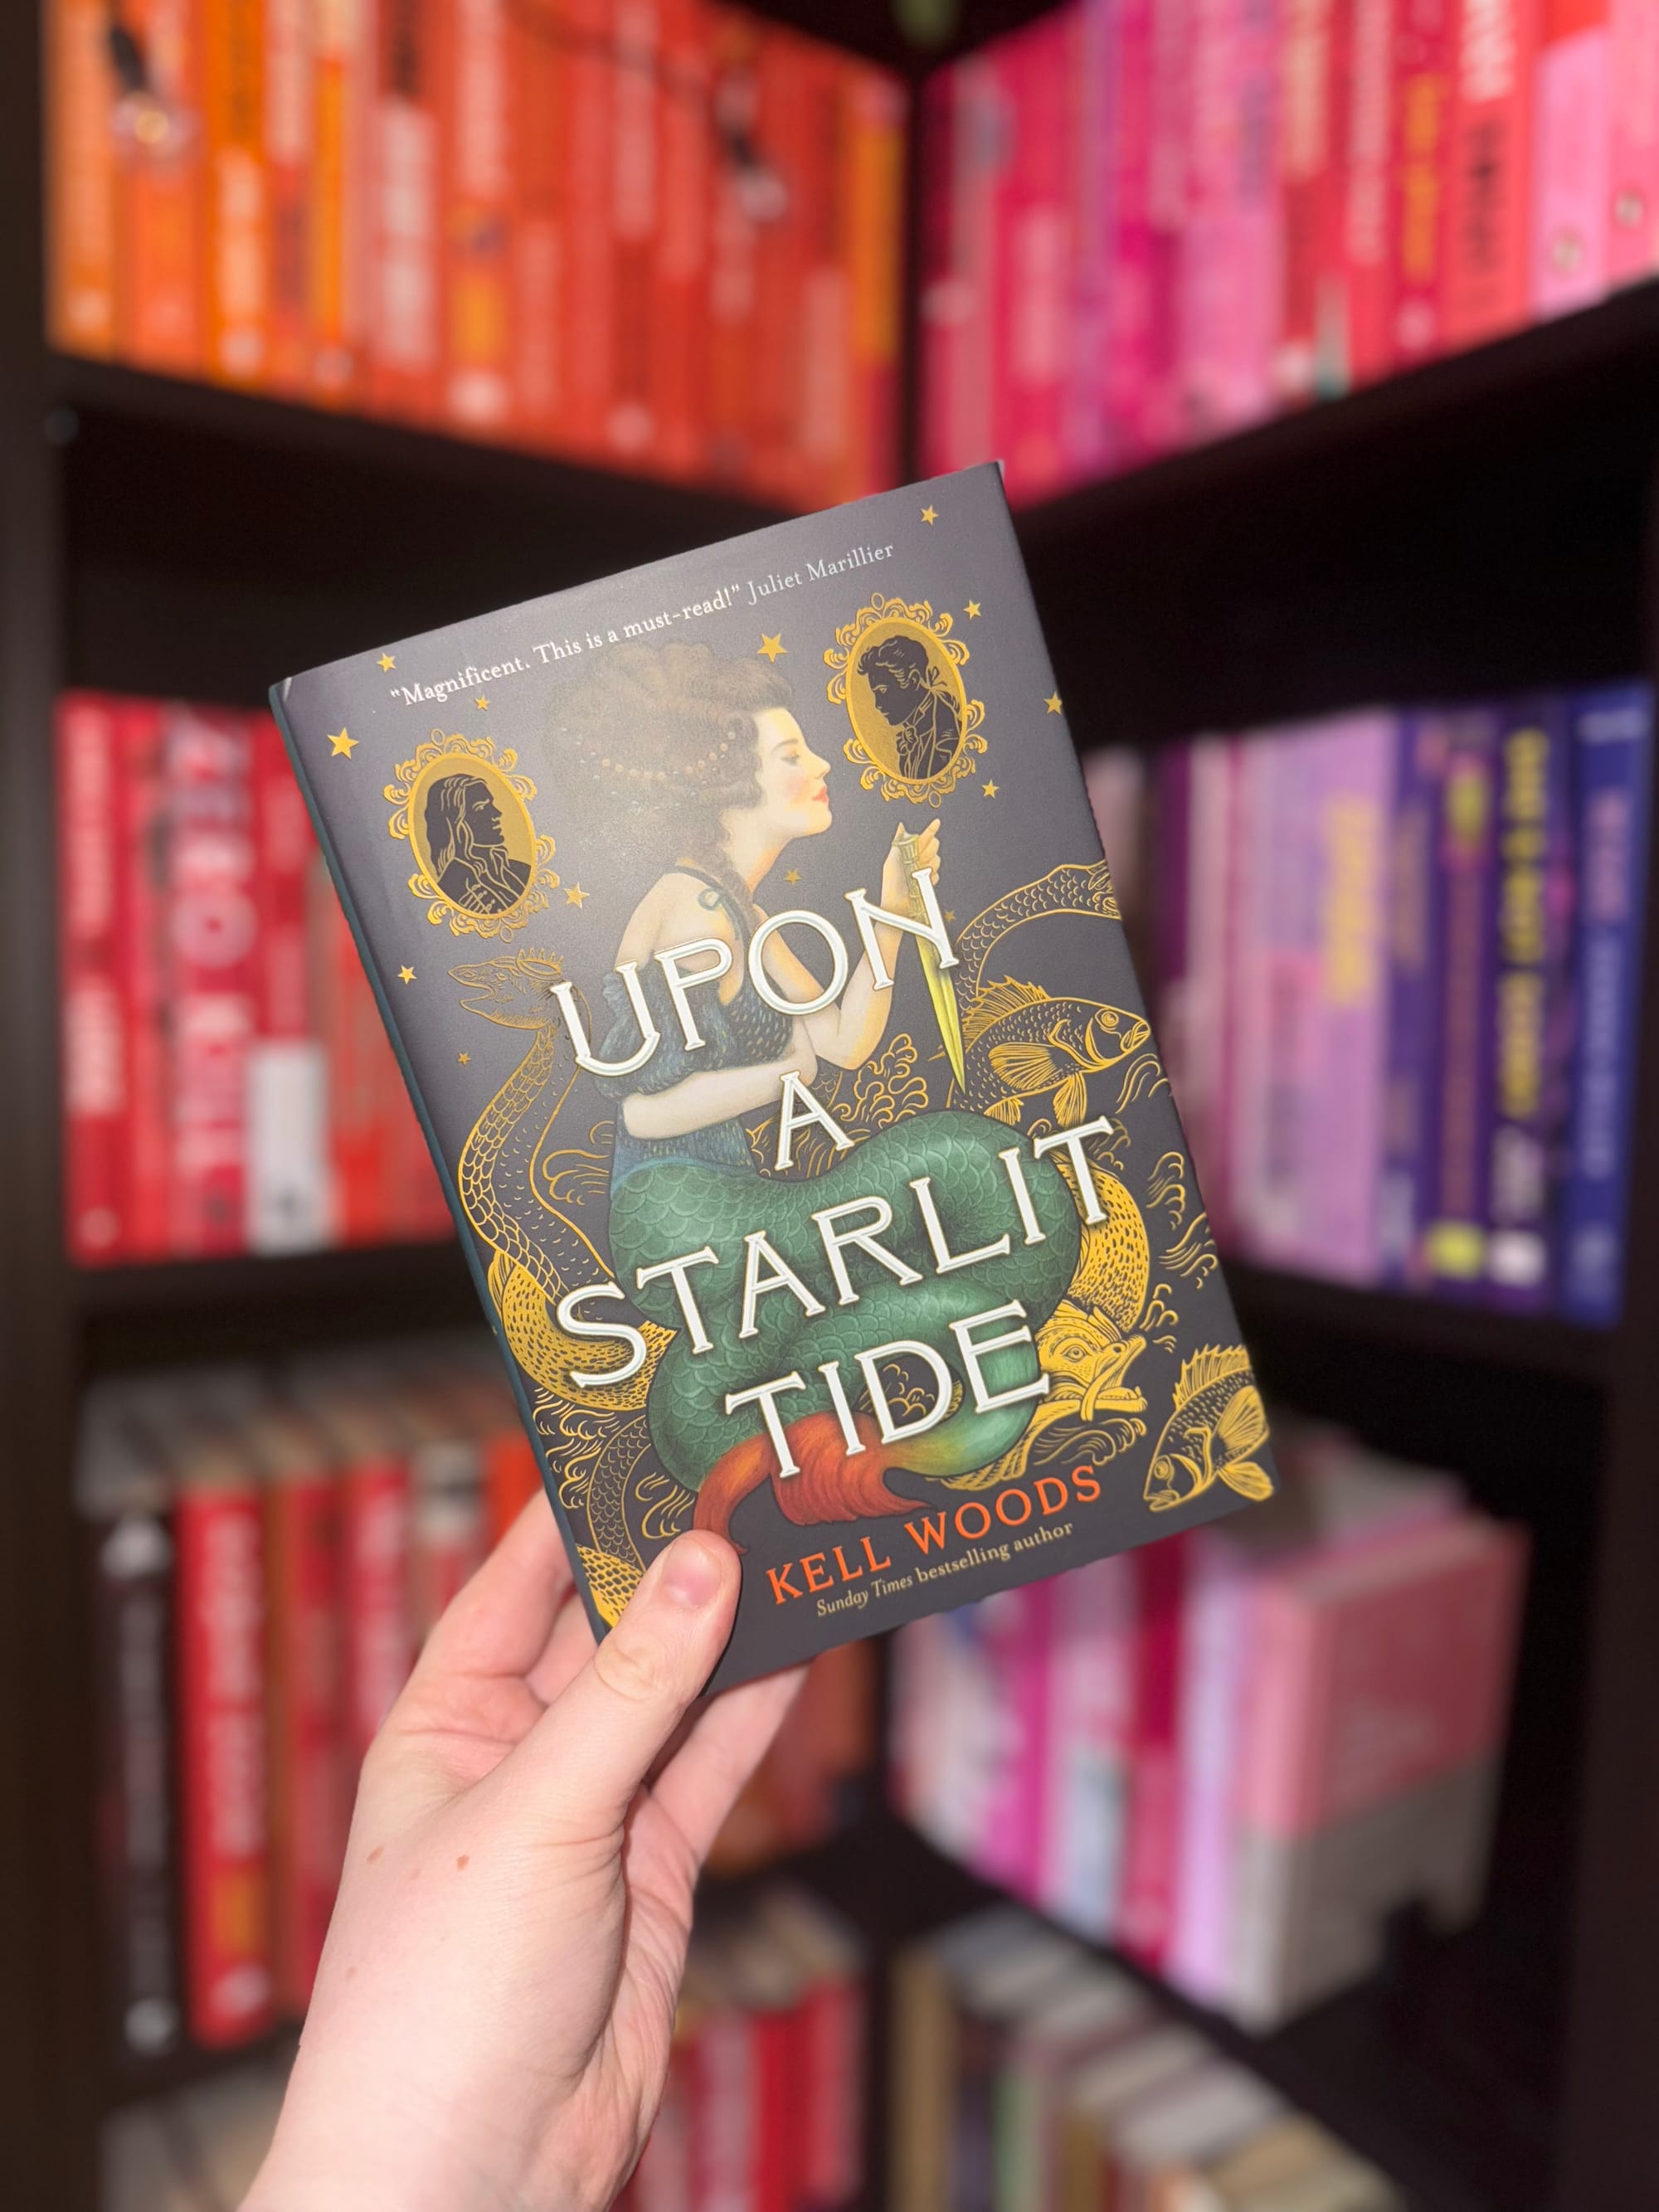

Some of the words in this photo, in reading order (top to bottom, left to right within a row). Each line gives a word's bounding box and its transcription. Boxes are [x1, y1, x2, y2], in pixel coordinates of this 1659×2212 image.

[533, 640, 582, 664] This
[586, 632, 604, 650] is
[607, 630, 620, 643] a
[747, 571, 803, 606] Juliet
[805, 543, 894, 581] Marillier
[549, 867, 960, 1077] UPON
[774, 1070, 854, 1172] A
[554, 1114, 1116, 1388] STARLIT
[724, 1299, 1049, 1480] TIDE
[766, 1535, 892, 1606] KELL
[903, 1464, 1102, 1555] WOODS
[816, 1587, 868, 1617] Sunday
[871, 1573, 913, 1600] Times
[915, 1543, 1011, 1583] bestselling
[1014, 1521, 1074, 1553] author
